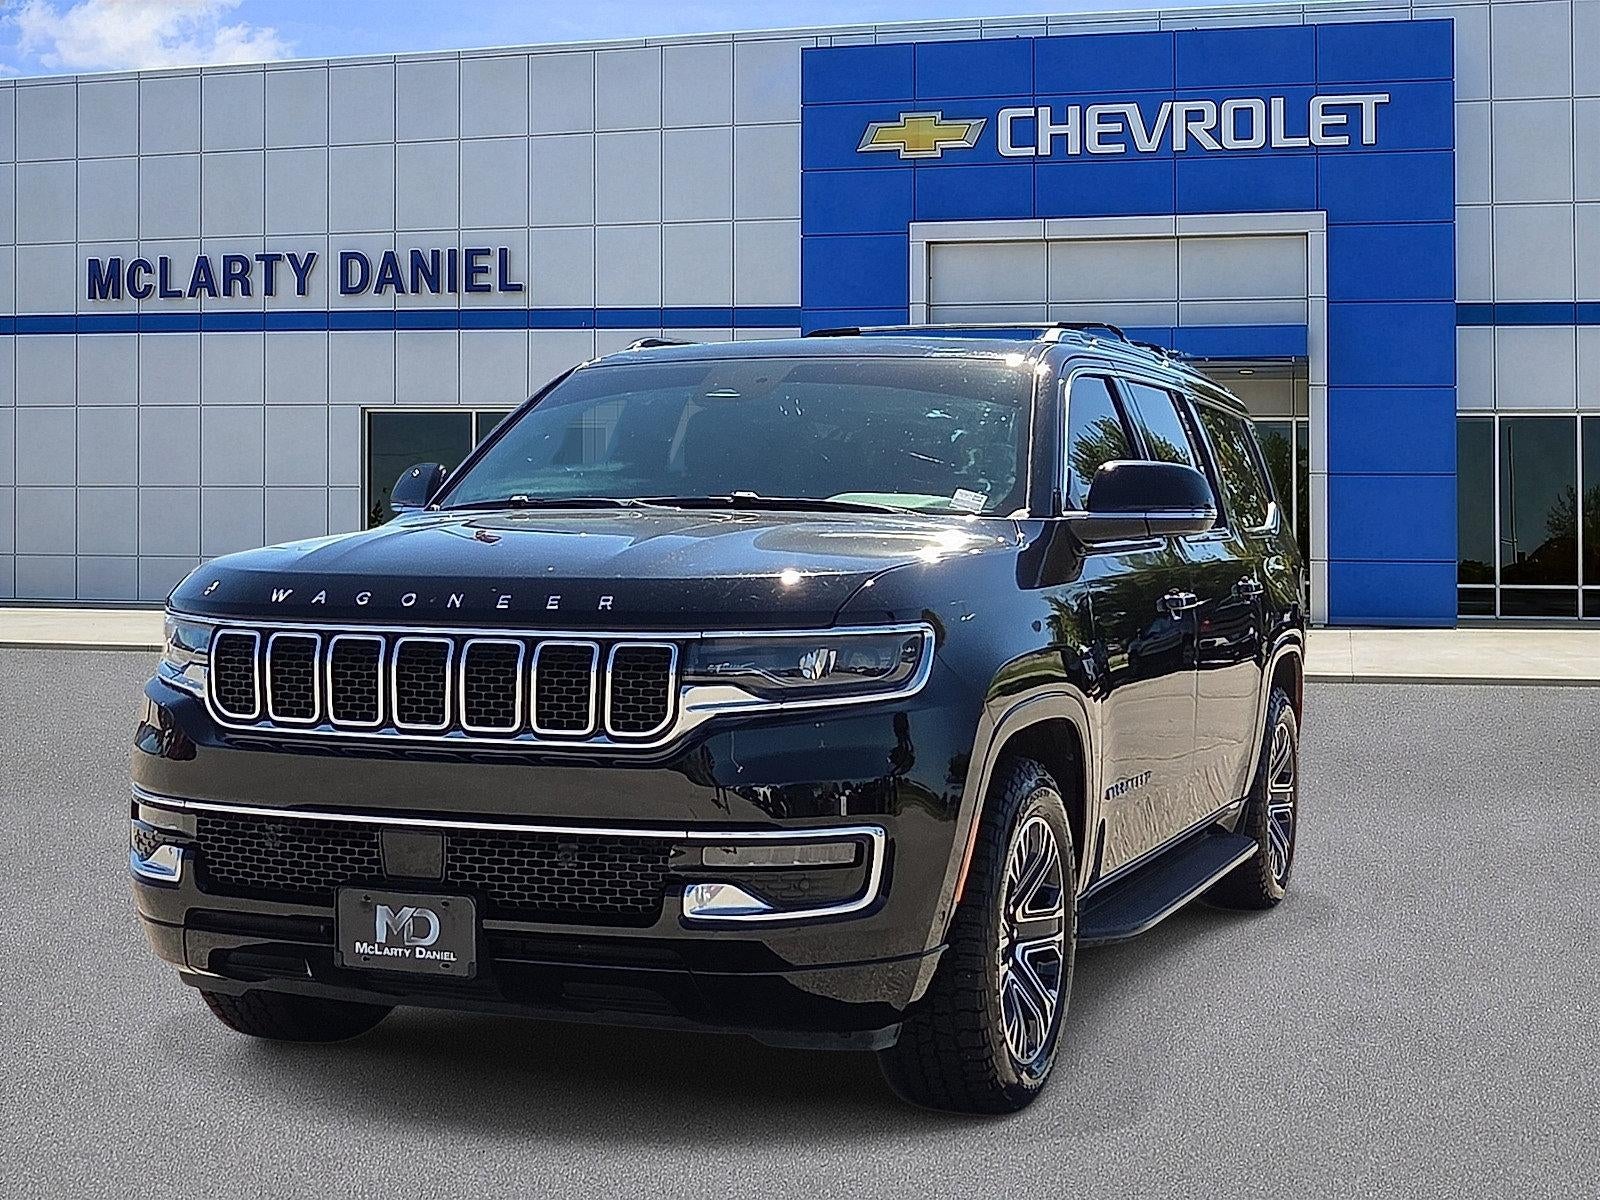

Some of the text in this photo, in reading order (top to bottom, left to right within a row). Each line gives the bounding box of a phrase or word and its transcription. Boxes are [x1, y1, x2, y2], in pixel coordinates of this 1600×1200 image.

[997, 93, 1390, 157] CHEVROLET
[339, 247, 525, 296] DANIEL
[271, 588, 614, 611] WAGONEER
[376, 904, 440, 946] MD
